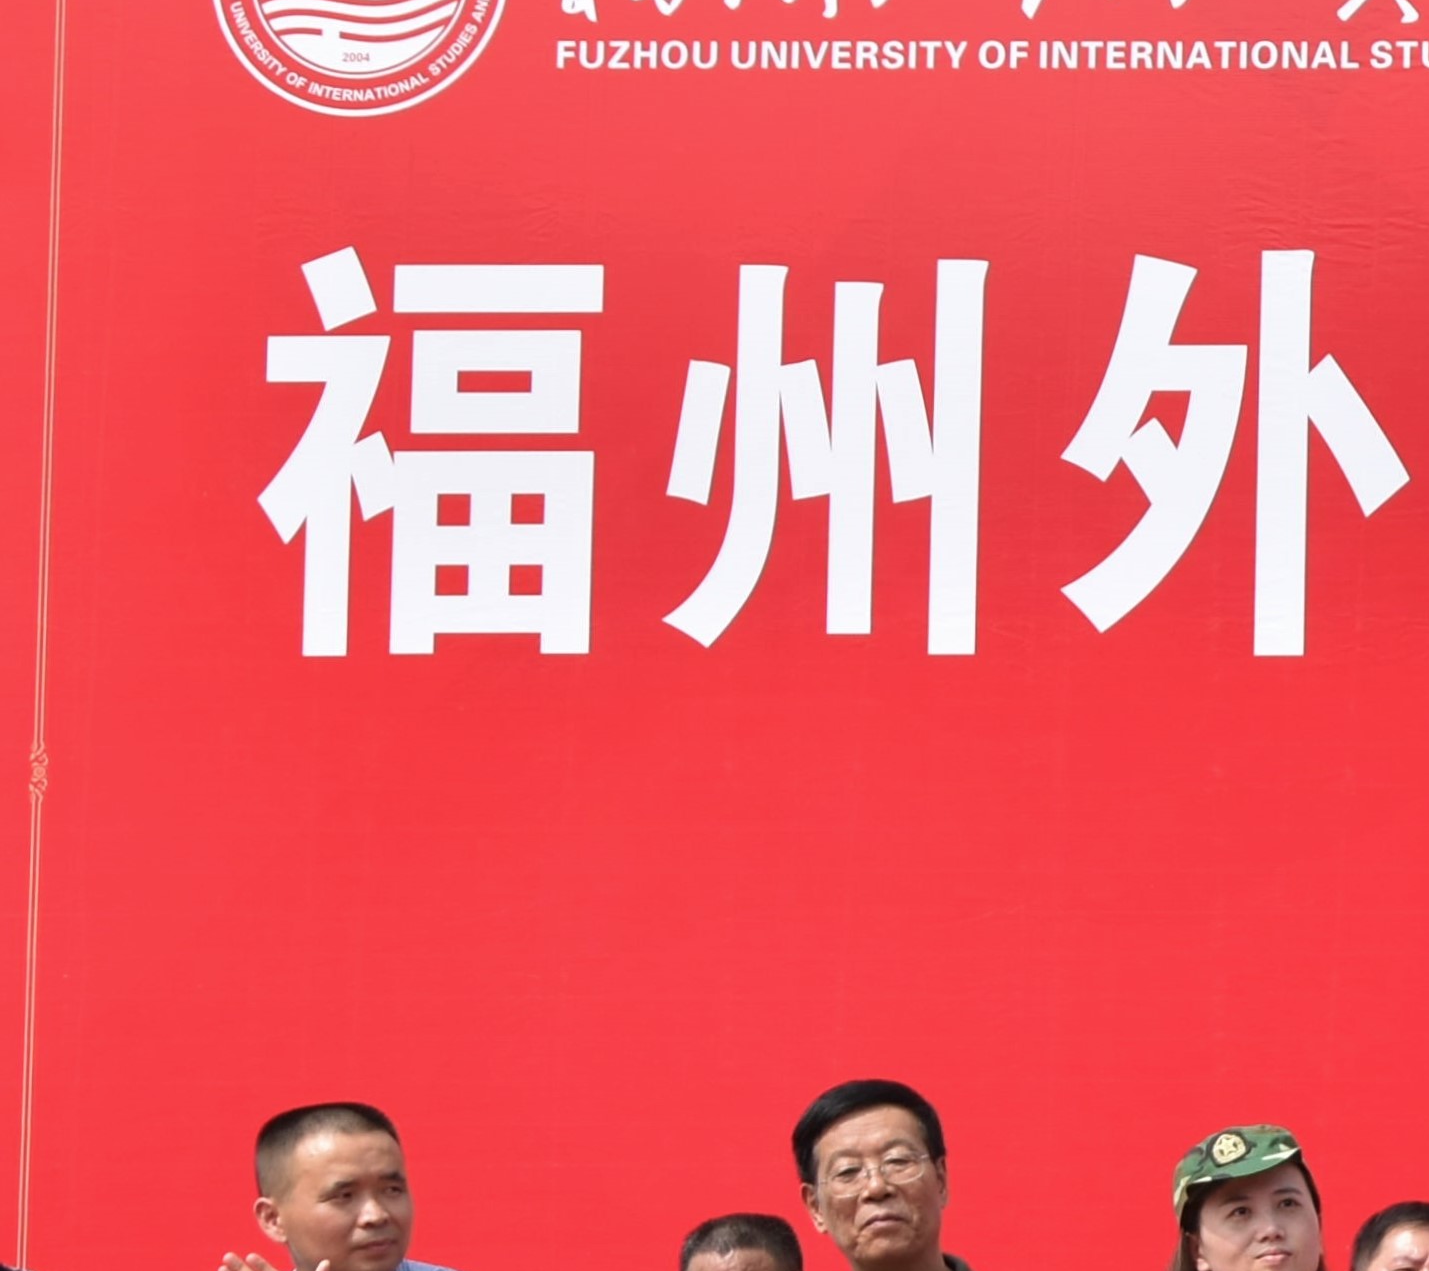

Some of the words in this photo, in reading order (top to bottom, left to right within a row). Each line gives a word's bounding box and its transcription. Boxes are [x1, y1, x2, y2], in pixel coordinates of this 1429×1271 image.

[230, 1, 287, 77] UNIVERSITY
[286, 71, 308, 88] OF
[308, 73, 430, 101] INTERNATIONAL
[429, 22, 478, 76] STUDIES
[342, 52, 370, 63] 2004
[557, 40, 717, 69] FUZHOU
[732, 40, 967, 70] UNIVERSITY
[979, 40, 1028, 69] OF
[1040, 40, 1359, 70] INTERNATIONAL
